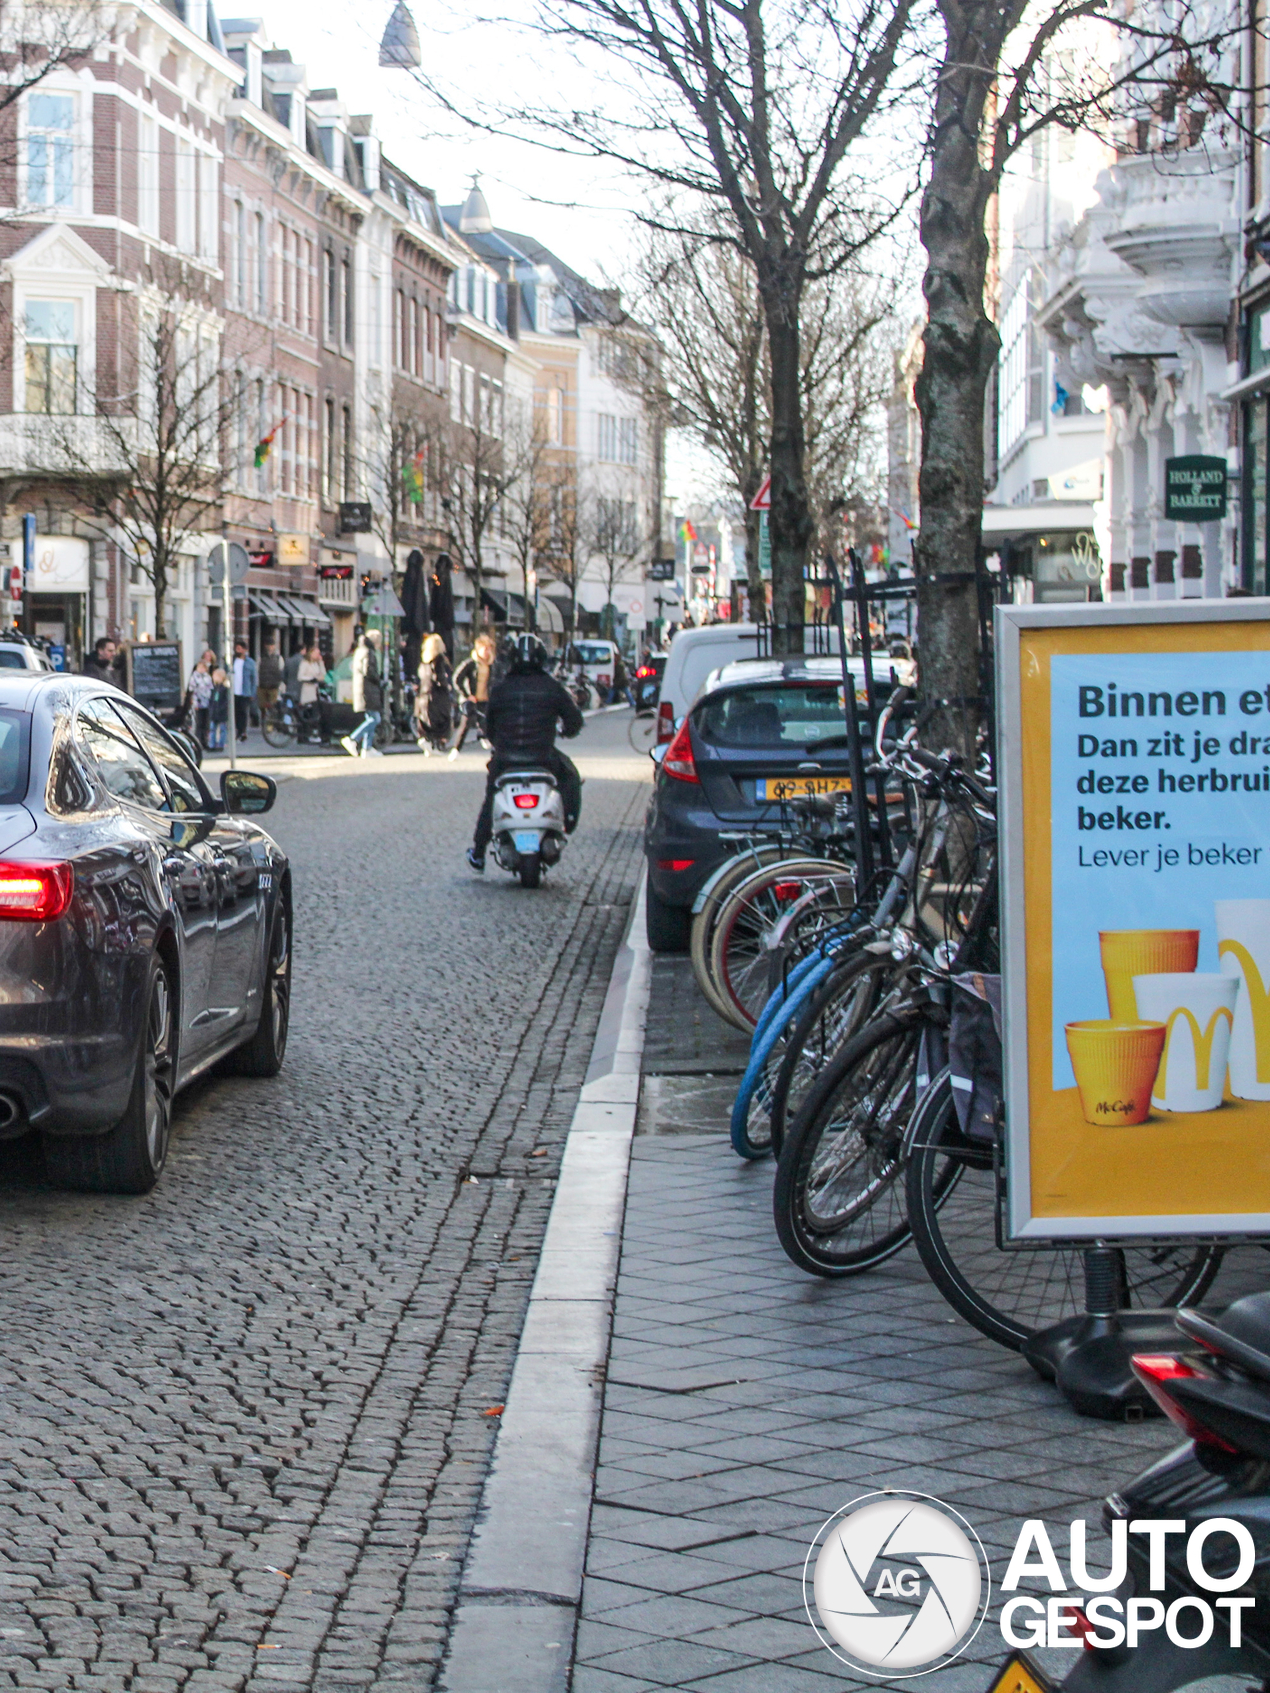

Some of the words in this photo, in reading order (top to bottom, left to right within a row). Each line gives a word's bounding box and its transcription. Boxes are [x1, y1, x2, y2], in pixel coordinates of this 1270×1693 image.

[1170, 470, 1224, 484] HOLLAND
[1170, 494, 1222, 508] BARRETT
[1078, 682, 1226, 718] Binnen
[1078, 734, 1138, 758] Dan
[1147, 730, 1185, 757] zit
[1190, 730, 1220, 763] je
[1077, 769, 1149, 794] deze
[1158, 766, 1270, 793] herbrui
[1078, 805, 1171, 831] beker.
[1079, 845, 1150, 867] Lever
[1154, 843, 1179, 873] je
[1188, 842, 1263, 865] beker
